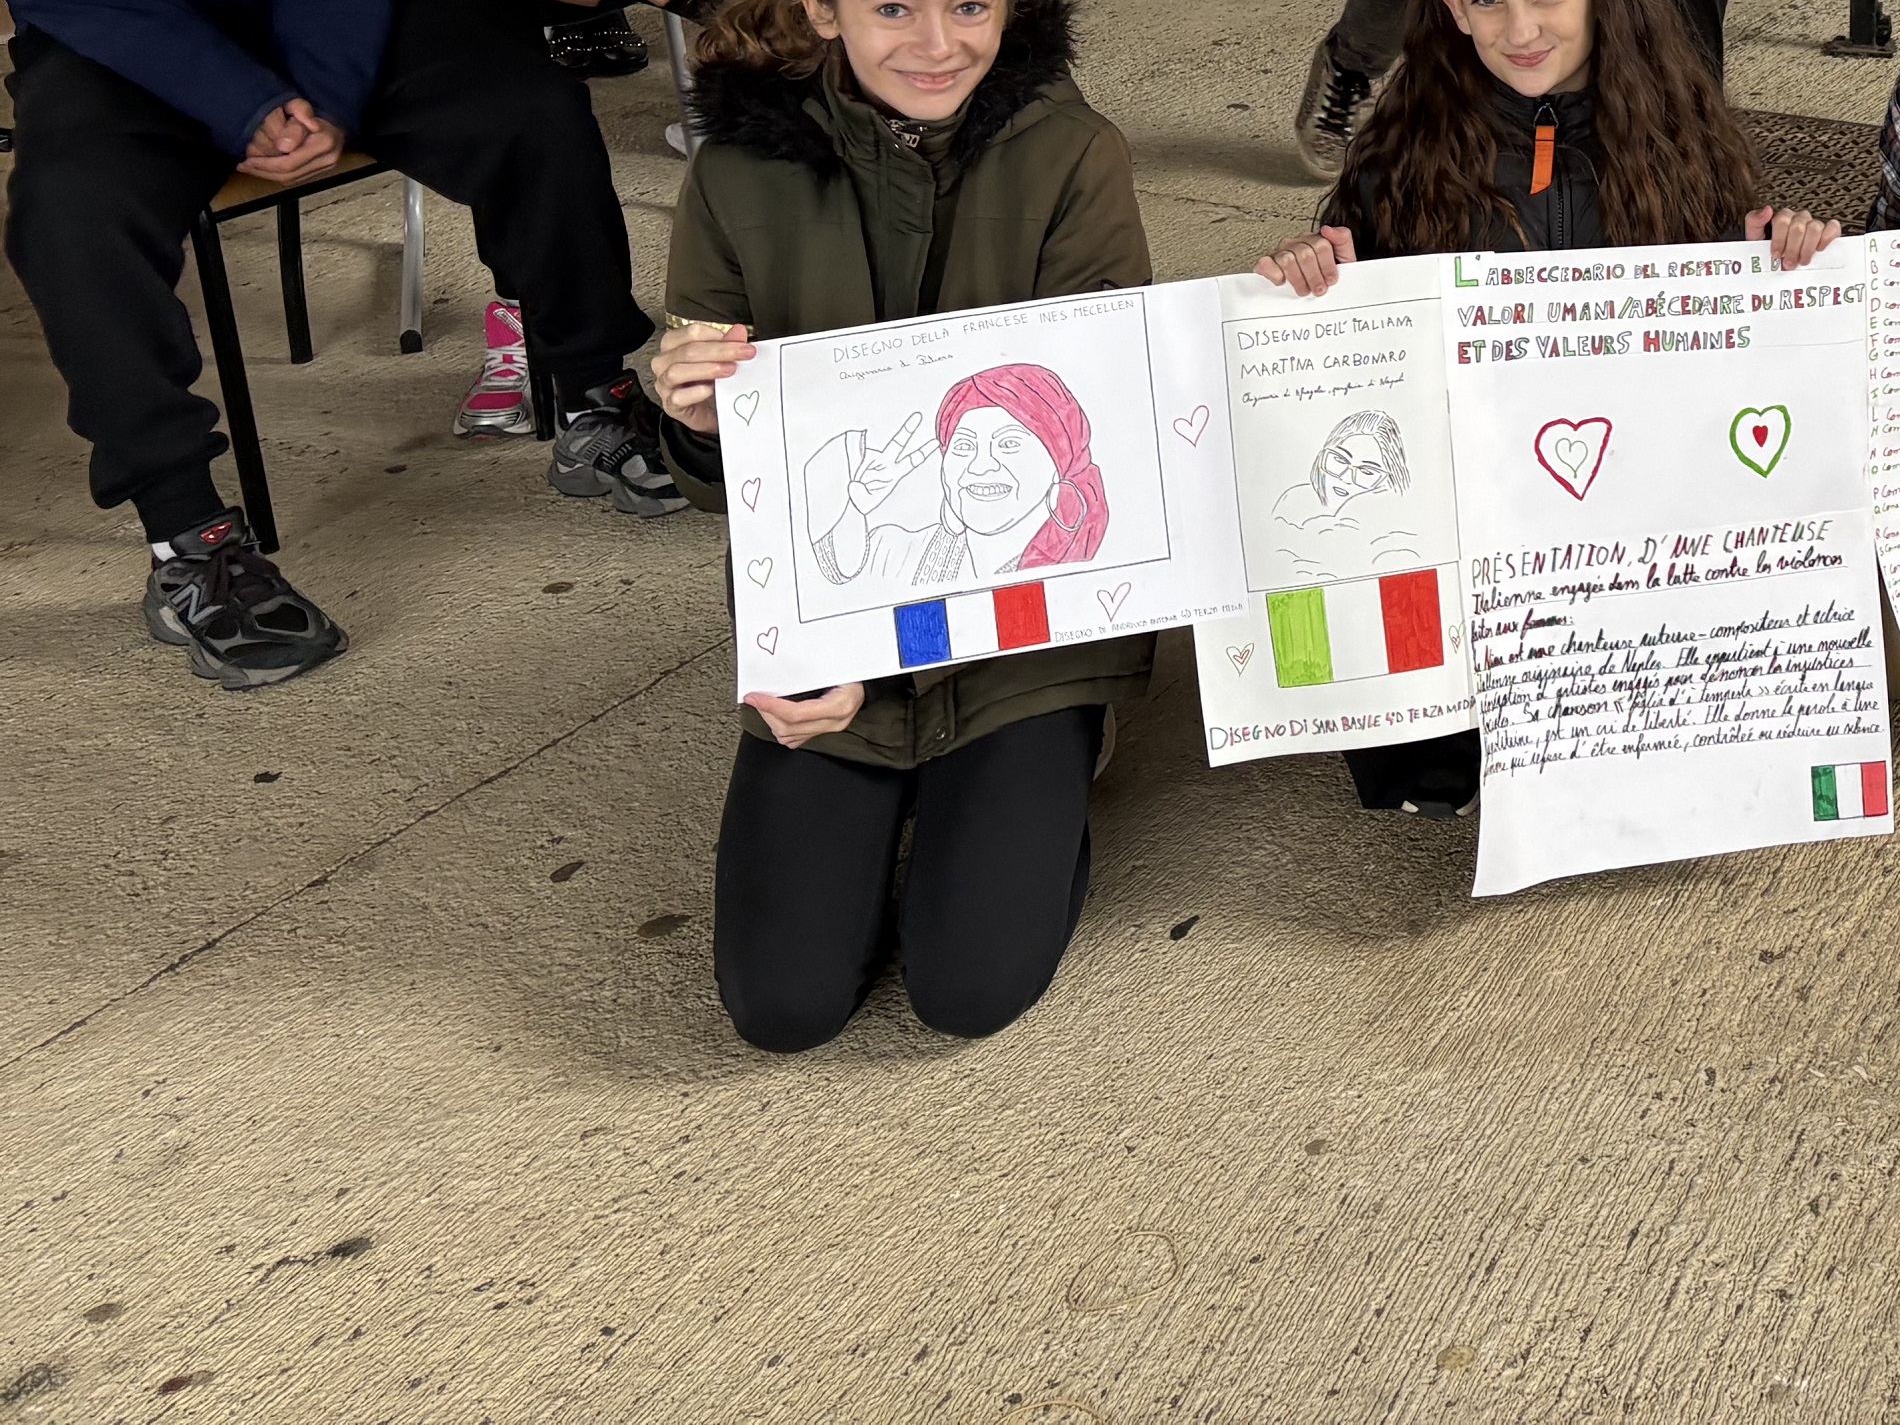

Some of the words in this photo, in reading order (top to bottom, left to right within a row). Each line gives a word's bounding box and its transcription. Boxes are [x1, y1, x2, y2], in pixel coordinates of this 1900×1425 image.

[1457, 303, 1535, 328] VALORI
[1752, 289, 1775, 313] DU
[1779, 282, 1865, 311] RESPECT
[833, 338, 904, 364] DISEGNO
[963, 312, 1029, 335] FRANCESE
[1039, 306, 1069, 325] INÈS
[1457, 342, 1487, 365] ET
[1491, 338, 1528, 361] DES
[1535, 332, 1631, 359] VALEURS
[1642, 326, 1752, 354] HUMAINES
[1240, 356, 1314, 379] MARTINA
[1323, 350, 1407, 368] CARBONARO
